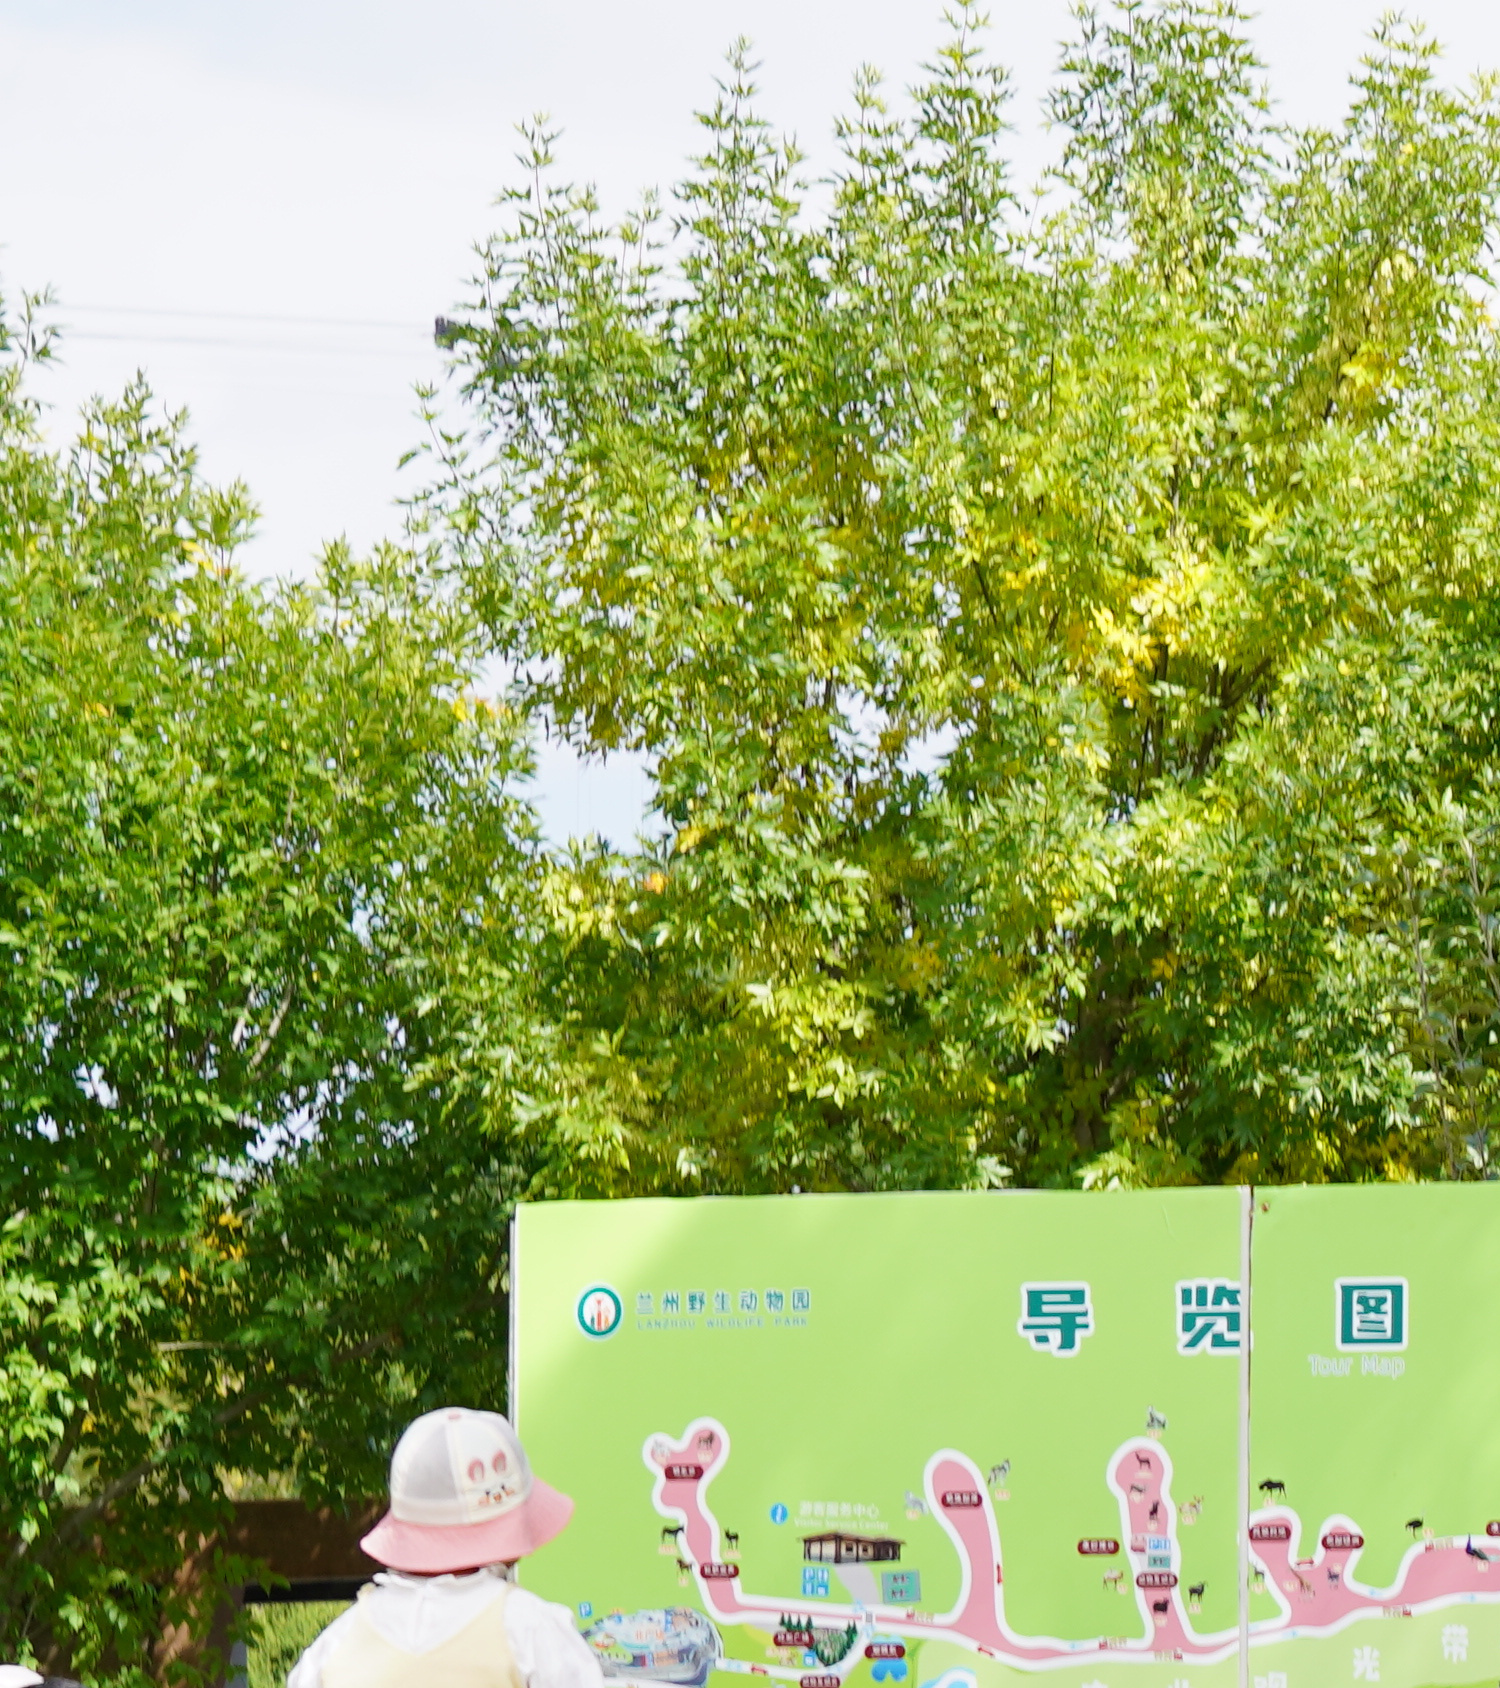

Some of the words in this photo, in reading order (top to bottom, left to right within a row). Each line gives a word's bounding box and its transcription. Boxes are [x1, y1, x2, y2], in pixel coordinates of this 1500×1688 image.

[637, 1289, 810, 1314] 兰州野生动物园
[637, 1319, 696, 1330] LANZHOU
[706, 1317, 764, 1328] WILDLIFE
[774, 1316, 808, 1326] PARK
[1021, 1282, 1405, 1351] 导览图
[1308, 1354, 1353, 1376] Tour
[1361, 1354, 1406, 1381] Map
[799, 1500, 880, 1519] 游客服务中心
